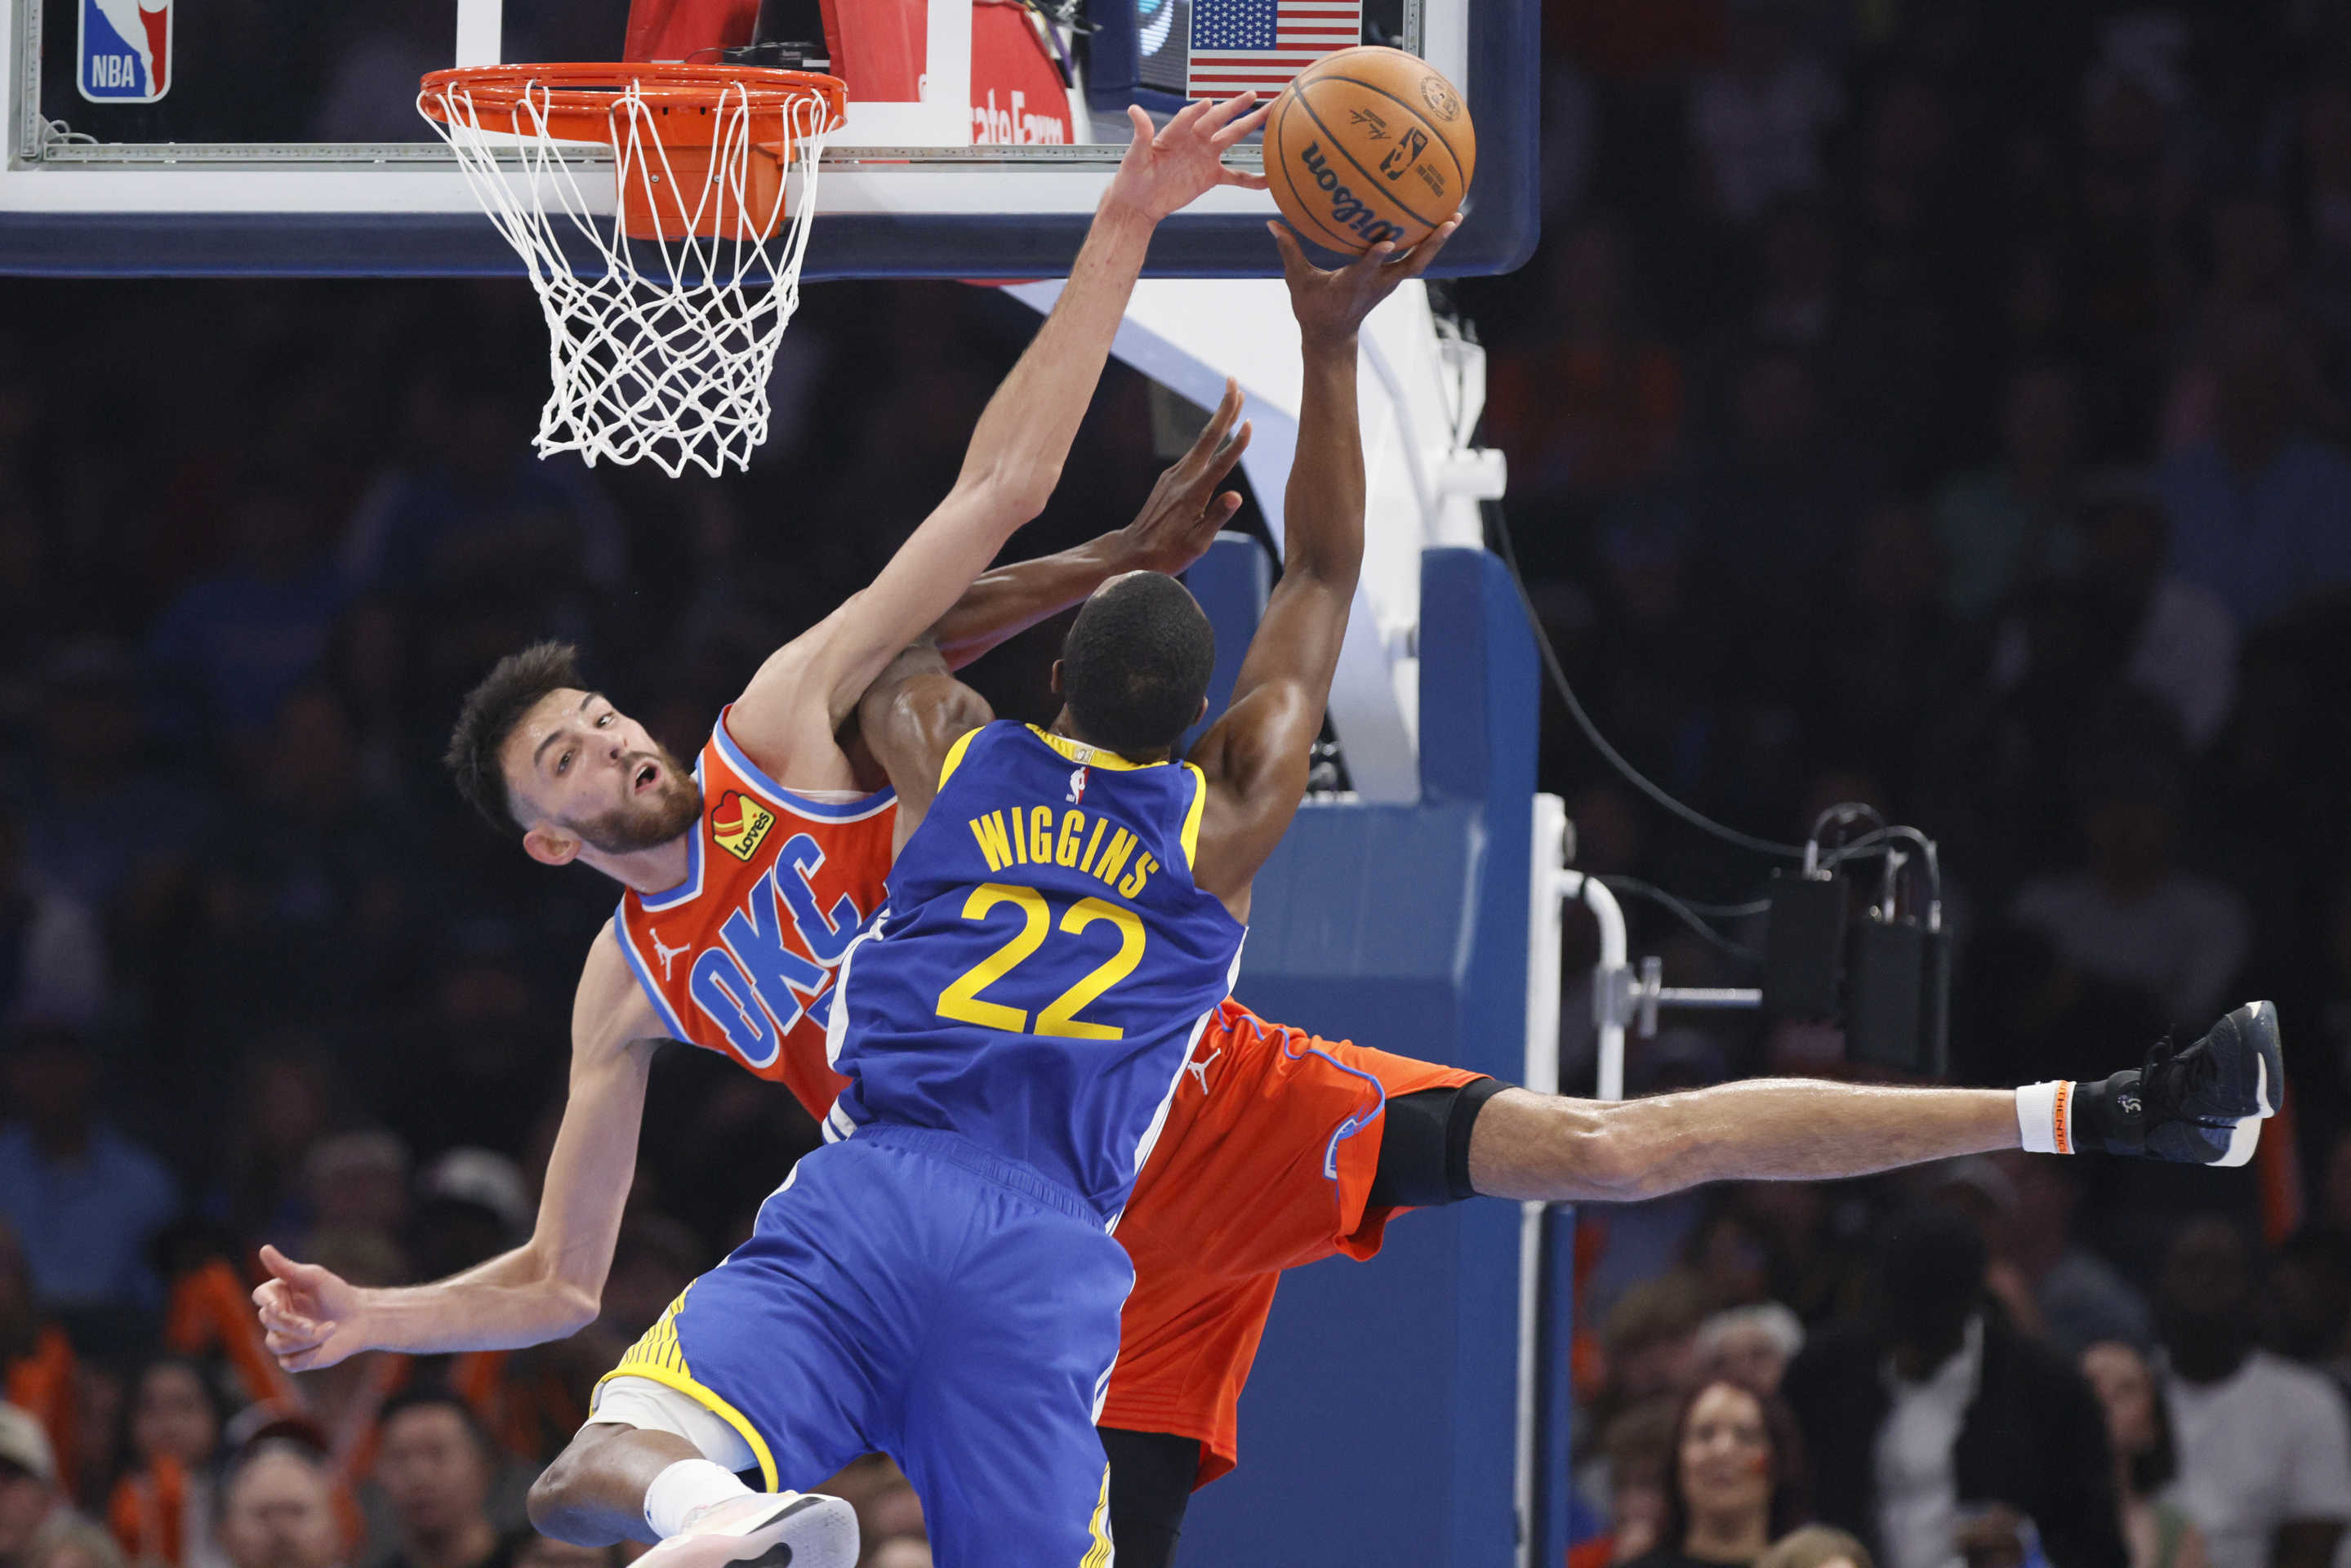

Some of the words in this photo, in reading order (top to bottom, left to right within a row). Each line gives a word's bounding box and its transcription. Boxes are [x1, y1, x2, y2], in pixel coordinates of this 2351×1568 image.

[92, 55, 135, 87] NBA
[969, 87, 1013, 144] ate
[1301, 139, 1405, 243] Wilson
[969, 805, 1160, 899] WIGGINS
[689, 832, 862, 1069] OKC
[935, 882, 1147, 1040] 22
